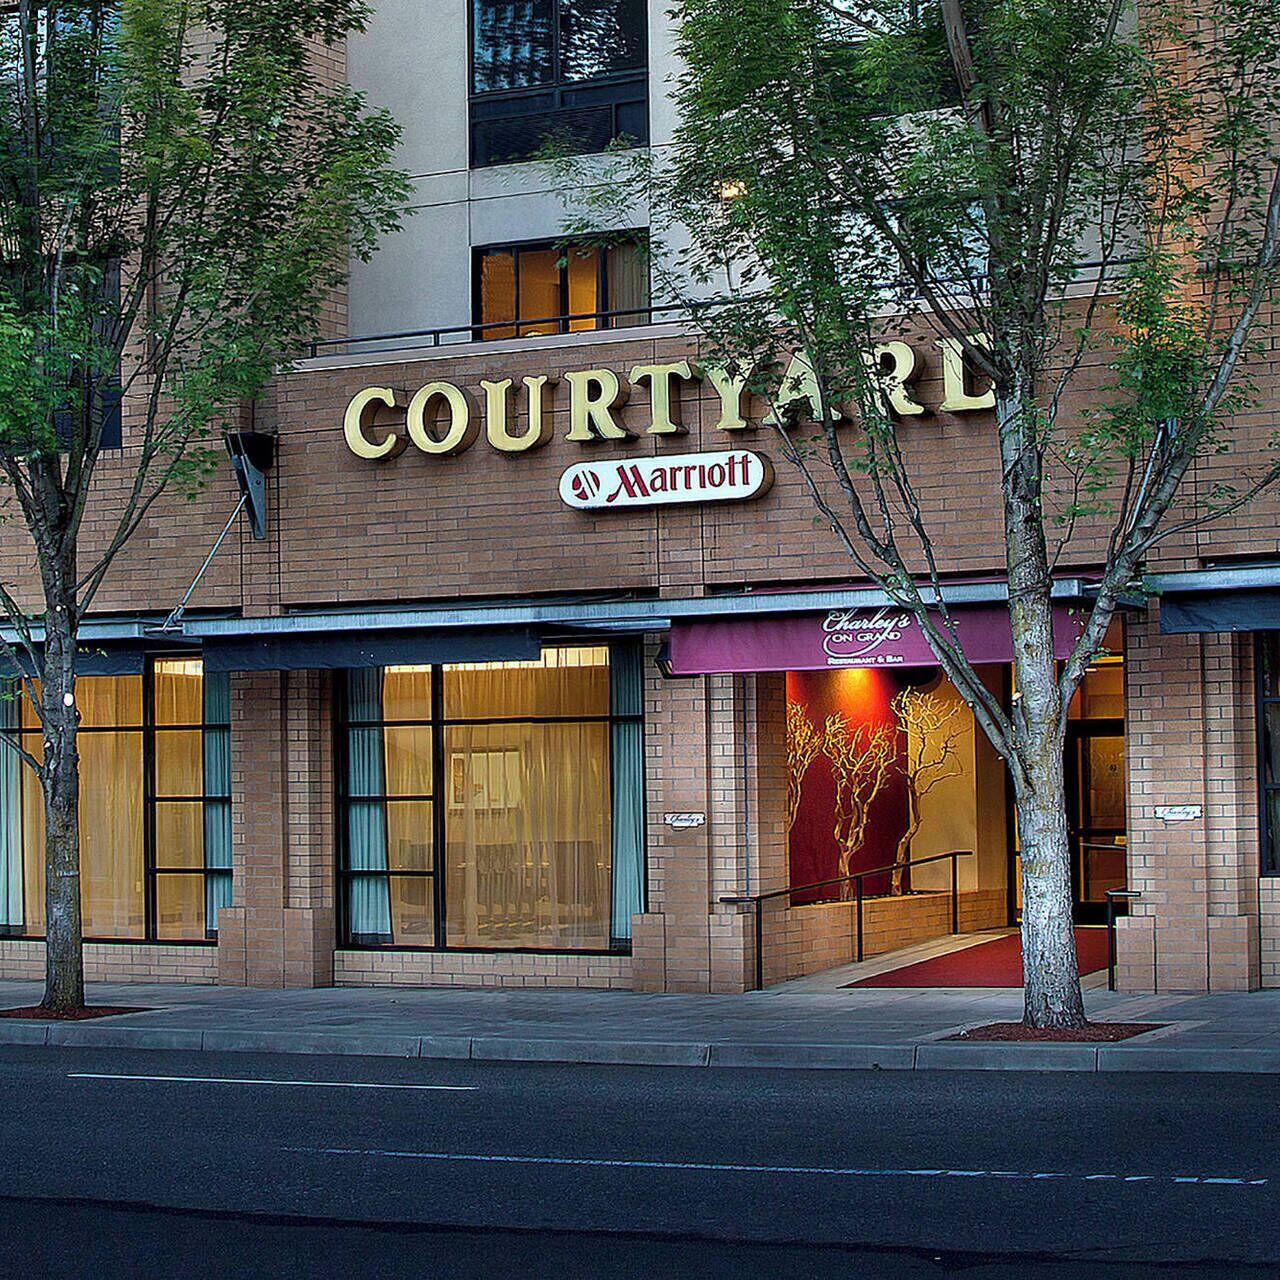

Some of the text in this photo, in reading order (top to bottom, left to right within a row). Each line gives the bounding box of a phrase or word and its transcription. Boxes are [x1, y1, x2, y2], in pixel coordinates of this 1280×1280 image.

[606, 454, 752, 503] Marriott
[822, 606, 911, 644] Charley's
[831, 633, 853, 642] ON
